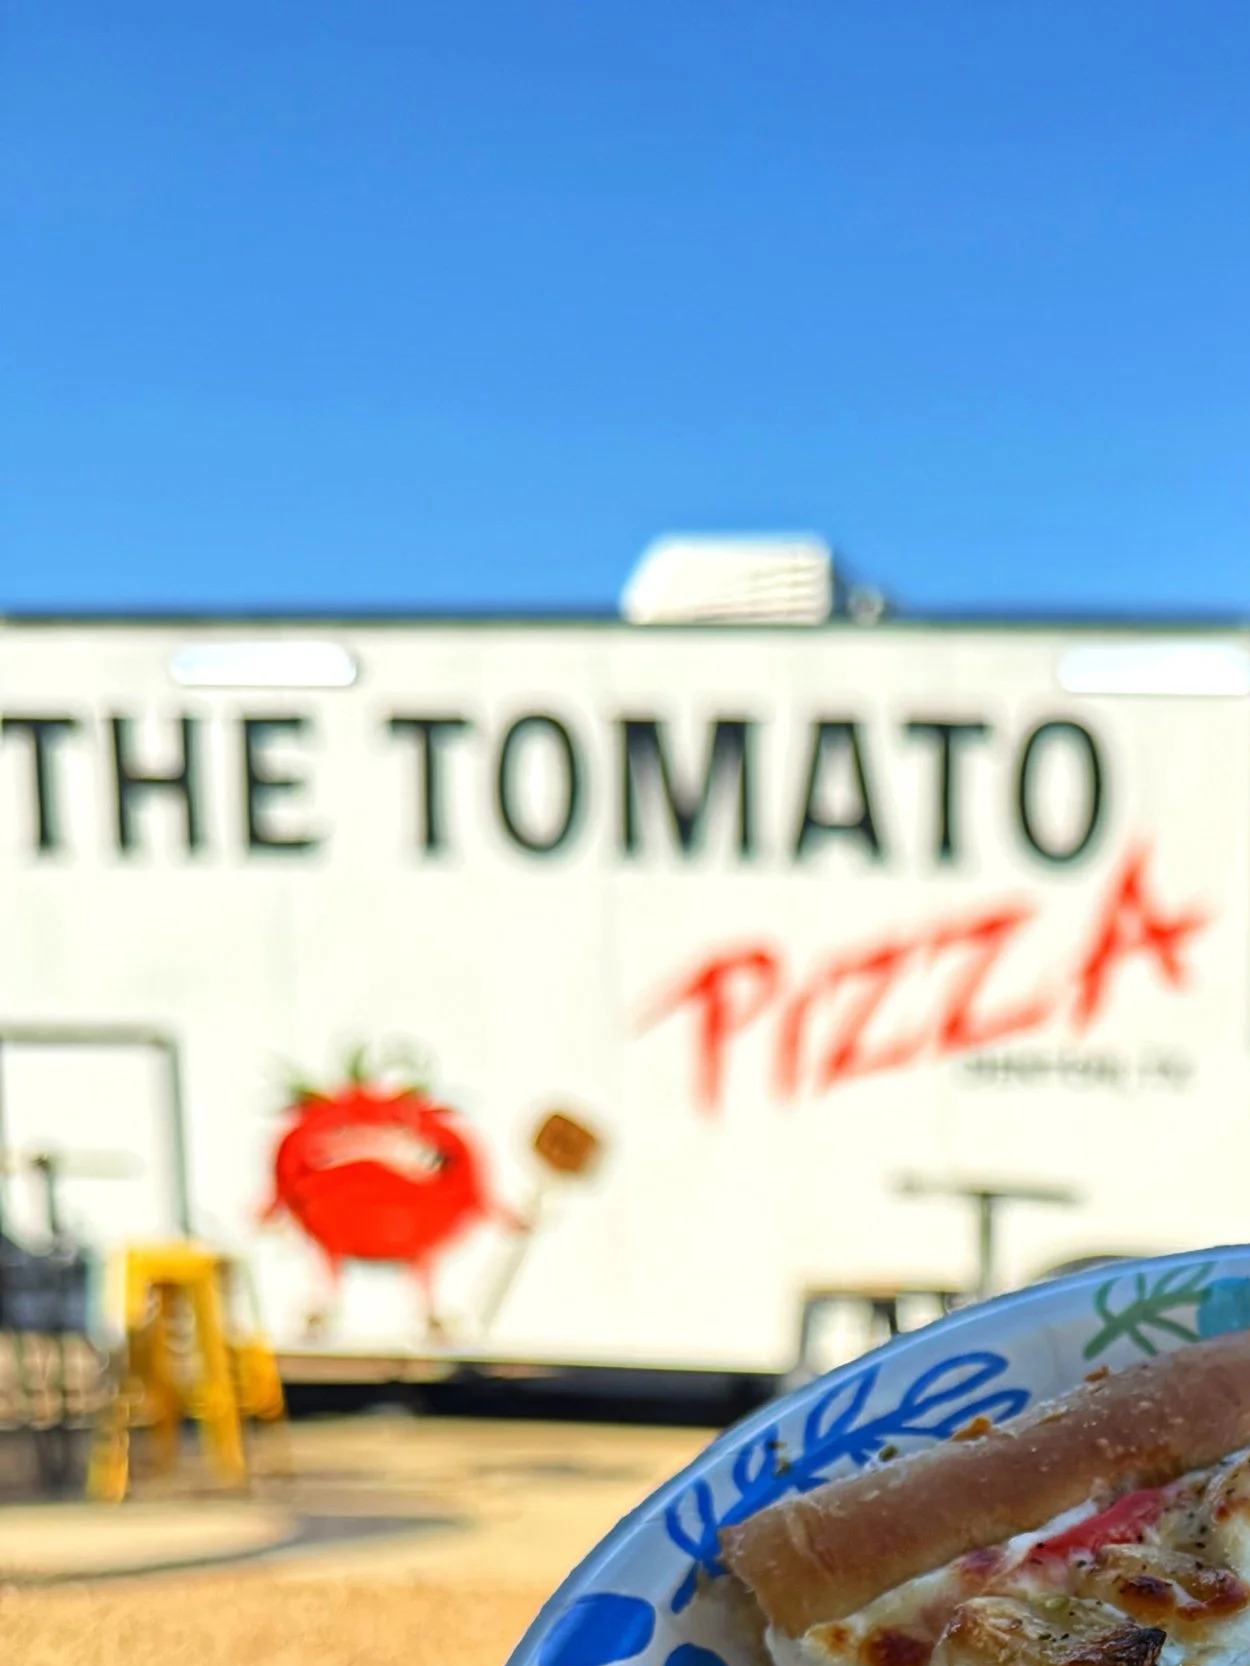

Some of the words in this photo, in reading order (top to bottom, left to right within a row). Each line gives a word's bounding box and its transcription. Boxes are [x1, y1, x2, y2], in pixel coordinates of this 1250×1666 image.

[0, 714, 323, 857] THE
[387, 714, 1108, 861] TOMATO
[637, 843, 1212, 1117] PIZZA
